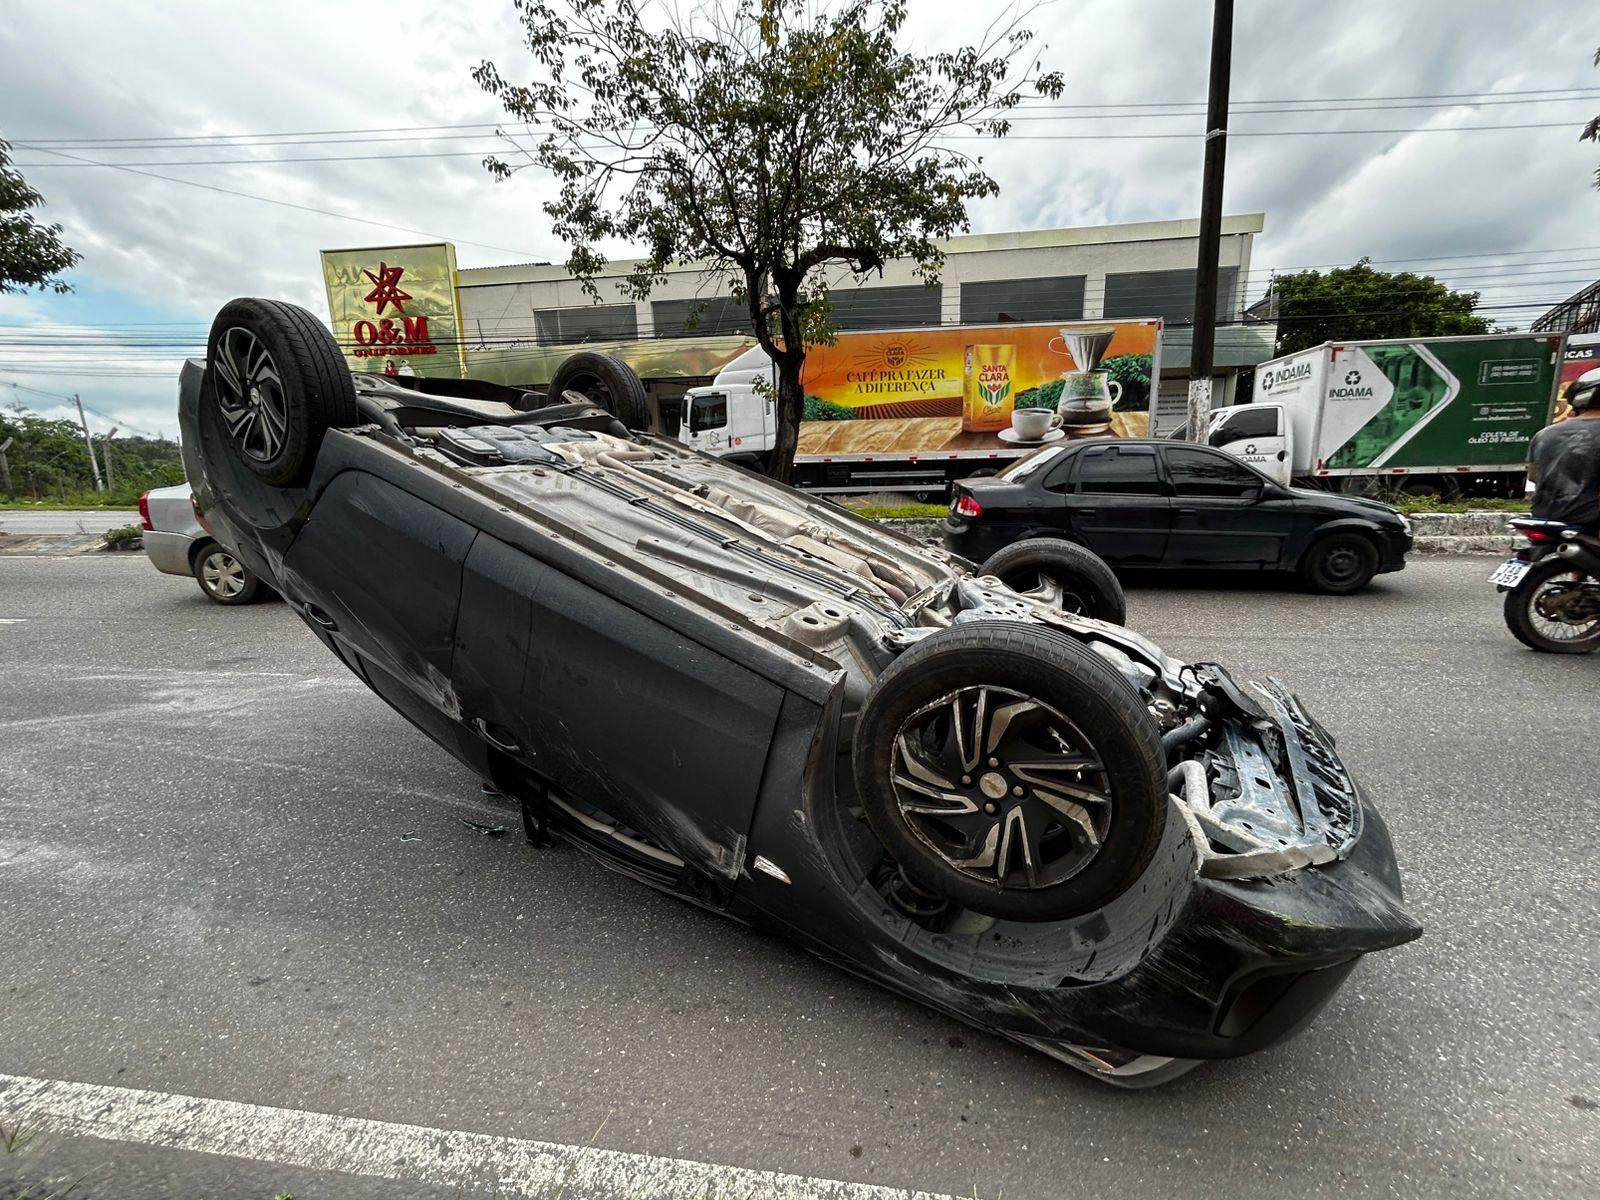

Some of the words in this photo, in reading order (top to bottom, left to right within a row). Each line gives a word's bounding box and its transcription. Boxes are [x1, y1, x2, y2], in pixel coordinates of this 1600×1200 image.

[354, 315, 432, 344] O&M
[846, 368, 878, 382] CAFÉ
[880, 370, 904, 381] PRA
[907, 368, 945, 380] FAZER
[982, 365, 1007, 373] SANTA
[1275, 363, 1311, 382] INDAMA
[979, 372, 1010, 382] CLARA
[854, 384, 863, 393] A
[865, 381, 935, 394] DIFERENÇA
[1329, 387, 1373, 398] INDAMA
